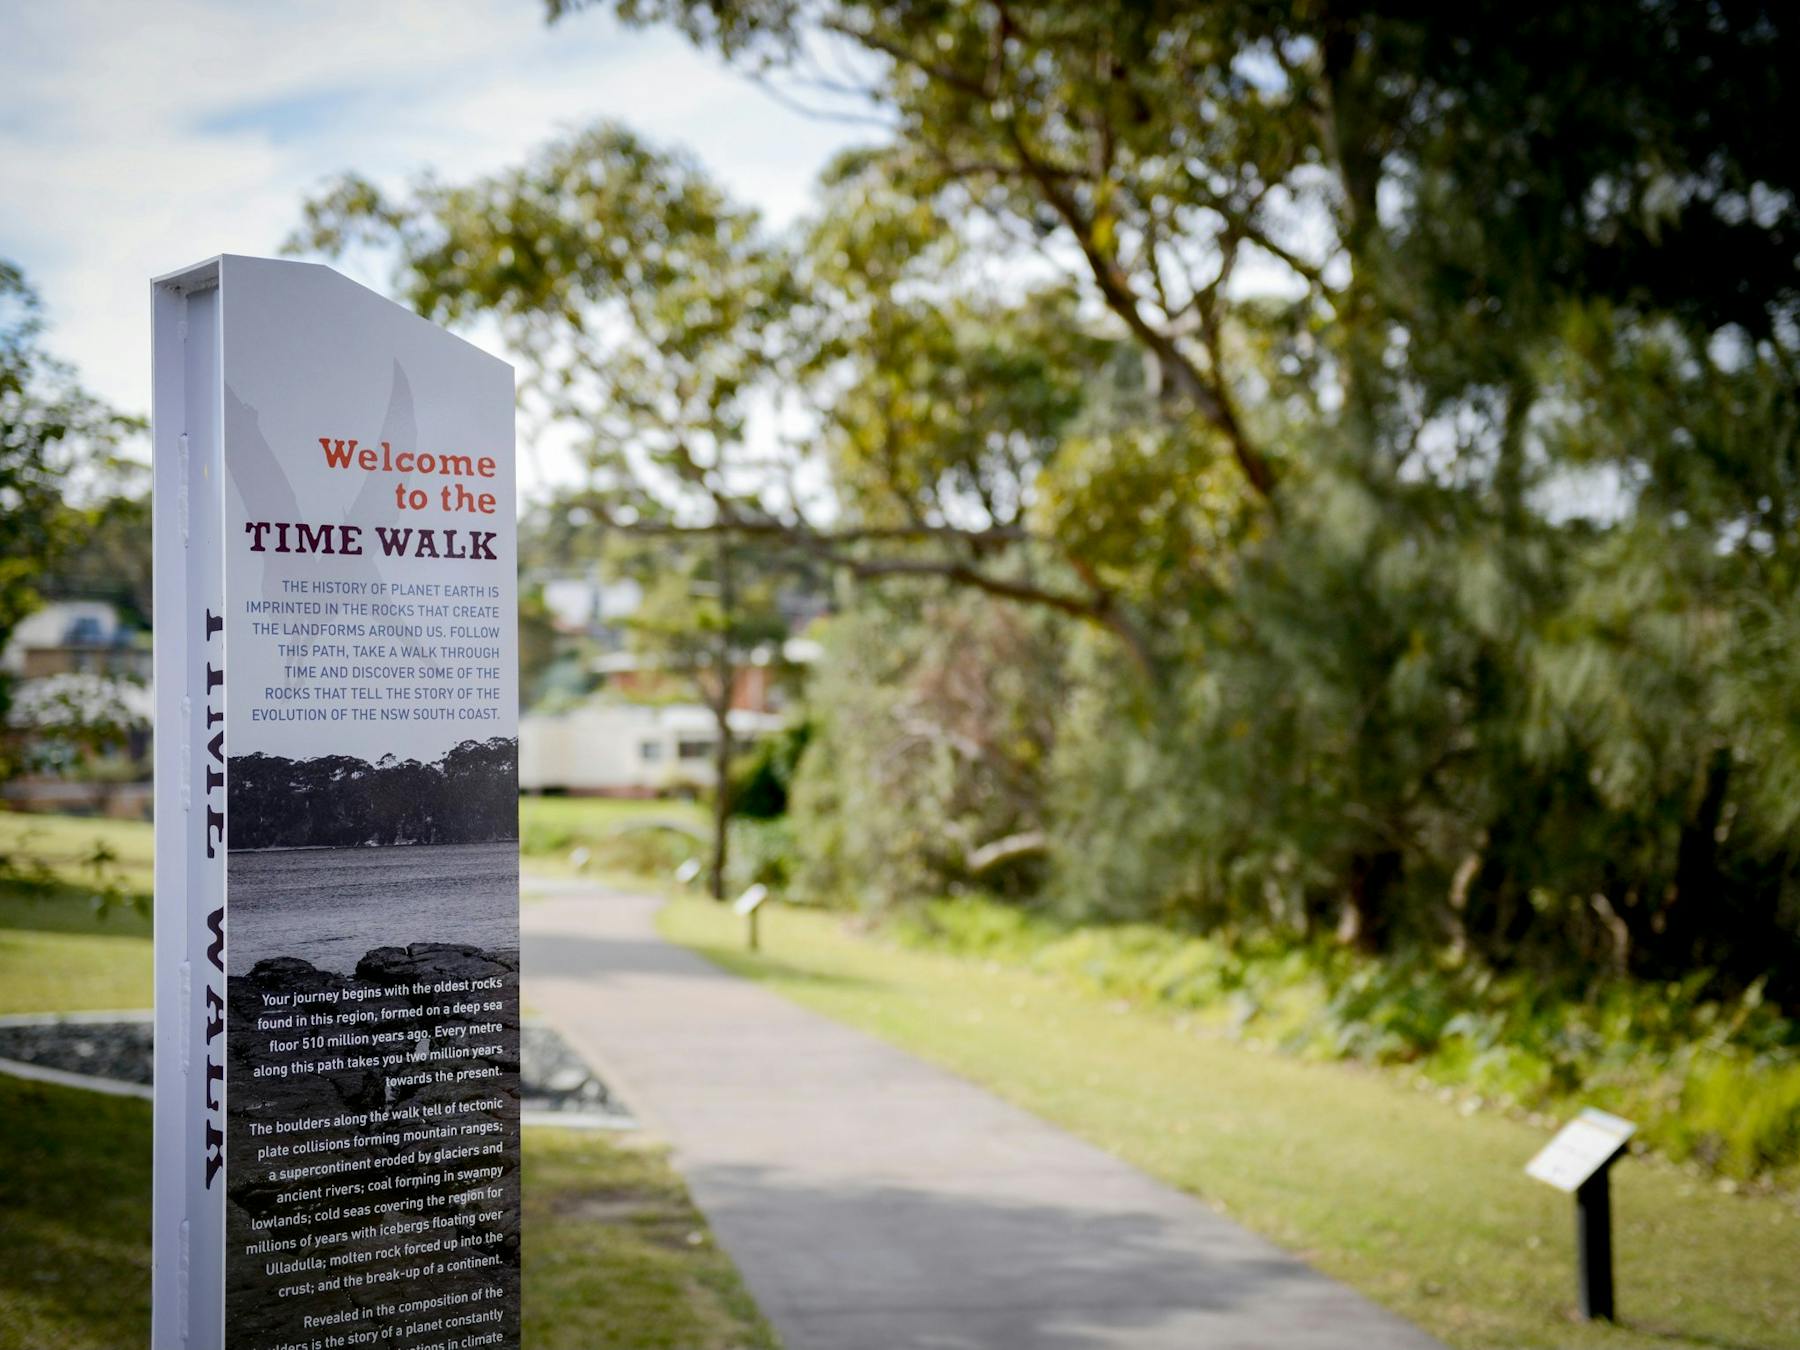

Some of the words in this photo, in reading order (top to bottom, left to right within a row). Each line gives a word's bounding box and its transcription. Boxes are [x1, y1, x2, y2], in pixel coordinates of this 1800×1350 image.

[319, 438, 496, 478] Welcome
[395, 483, 428, 511] to
[440, 484, 497, 514] the
[245, 522, 362, 554] TIME
[375, 527, 497, 560] WALK
[281, 580, 308, 592] THE
[312, 580, 367, 594] HISTORY
[370, 582, 386, 594] OF
[391, 584, 440, 596] PLANET
[444, 585, 484, 596] EARTH
[488, 586, 498, 597] IS
[246, 601, 320, 614] IMPRINTED
[325, 602, 338, 614] IN
[342, 602, 367, 615] THE
[372, 603, 414, 616] ROCKS
[418, 605, 448, 616] THAT
[453, 606, 498, 617] CREATE
[252, 622, 279, 634] THE
[283, 623, 365, 636] LANDFORMS
[368, 625, 422, 636] AROUND
[426, 626, 445, 637] US.
[450, 626, 499, 638] FOLLOW
[278, 644, 308, 656] THIS
[312, 644, 348, 658] PATH,
[352, 645, 385, 657] TAKE
[388, 646, 397, 657] A
[400, 646, 437, 657] WALK
[440, 646, 499, 658] THROUGH
[284, 665, 316, 678] TIME
[320, 666, 348, 678] AND
[352, 666, 414, 678] DISCOVER
[418, 666, 453, 678] SOME
[457, 667, 472, 678] OF
[476, 667, 499, 678] THE
[265, 687, 310, 699] ROCKS
[314, 687, 347, 699] THAT
[350, 687, 382, 699] TELL
[386, 687, 410, 699] THE
[414, 687, 454, 699] STORY
[457, 688, 472, 698] OF
[476, 687, 499, 698] THE
[252, 708, 326, 720] EVOLUTION
[330, 708, 347, 720] OF
[351, 708, 376, 720] THE
[380, 708, 410, 720] NSW
[413, 708, 454, 719] SOUTH
[458, 708, 500, 720] COAST.
[262, 993, 290, 1005] Your
[293, 991, 339, 1006] journey
[342, 986, 381, 1001] begins
[384, 984, 409, 996] with
[412, 982, 431, 994] the
[434, 979, 469, 992] oldest
[470, 978, 502, 992] rocks
[257, 1015, 292, 1029] found
[296, 1014, 307, 1026] in
[310, 1012, 333, 1025] this
[336, 1009, 378, 1025] region,
[380, 1005, 422, 1019] formed
[426, 1006, 440, 1015] on
[442, 1005, 450, 1014] a
[452, 1001, 480, 1014] deep
[482, 1000, 503, 1010] sea
[269, 1039, 299, 1051] floor
[302, 1036, 324, 1049] 510
[327, 1032, 368, 1046] million
[371, 1031, 404, 1045] years
[406, 1029, 431, 1043] ago.
[434, 1025, 466, 1038] Every
[469, 1022, 502, 1034] metre
[253, 1064, 287, 1077] along
[291, 1060, 314, 1073] this
[317, 1057, 344, 1073] path
[347, 1055, 379, 1067] takes
[382, 1054, 402, 1067] you
[406, 1052, 427, 1062] two
[430, 1047, 469, 1060] million
[471, 1044, 503, 1058] years
[386, 1075, 432, 1088] towards
[435, 1070, 453, 1081] the
[456, 1067, 502, 1082] present.
[249, 1123, 272, 1135] The
[276, 1117, 330, 1132] boulders
[333, 1114, 367, 1126] along
[369, 1110, 388, 1122] the
[391, 1106, 419, 1119] walk
[422, 1104, 442, 1116] tell
[444, 1101, 456, 1114] of
[458, 1097, 503, 1112] tectonic
[258, 1145, 289, 1161] plate
[292, 1138, 350, 1154] collisions
[353, 1132, 400, 1146] forming
[403, 1124, 457, 1141] mountain
[460, 1122, 502, 1136] ranges;
[268, 1171, 276, 1180] a
[279, 1158, 370, 1180] supercontinent
[374, 1151, 414, 1167] eroded
[418, 1150, 431, 1164] by
[434, 1145, 480, 1163] glaciers
[482, 1141, 502, 1154] and
[276, 1186, 322, 1203] ancient
[325, 1184, 364, 1196] rivers;
[367, 1177, 392, 1191] coal
[394, 1172, 440, 1188] forming
[444, 1170, 454, 1181] in
[457, 1166, 504, 1181] swampy
[251, 1212, 311, 1230] lowlands;
[314, 1207, 340, 1221] cold
[343, 1205, 370, 1217] seas
[374, 1197, 423, 1213] covering
[426, 1194, 445, 1206] the
[448, 1187, 484, 1205] region
[486, 1186, 504, 1198] for
[246, 1239, 296, 1254] millions
[299, 1234, 311, 1246] of
[314, 1232, 348, 1248] years
[350, 1225, 376, 1239] with
[380, 1220, 429, 1236] icebergs
[432, 1213, 475, 1228] floating
[478, 1210, 503, 1221] over
[266, 1257, 326, 1275] Ulladulla;
[330, 1251, 372, 1265] molten
[375, 1245, 401, 1259] rock
[404, 1238, 440, 1255] forced
[443, 1239, 458, 1251] up
[460, 1234, 482, 1247] into
[485, 1231, 503, 1243] the
[278, 1282, 314, 1297] crust;
[318, 1276, 340, 1291] and
[343, 1274, 362, 1287] the
[366, 1267, 420, 1283] break-up
[422, 1262, 434, 1275] of
[436, 1264, 444, 1273] a
[446, 1253, 502, 1271] continent.
[304, 1308, 358, 1328] Revealed
[362, 1306, 372, 1318] in
[376, 1304, 395, 1316] the
[398, 1292, 468, 1312] composition
[471, 1288, 482, 1300] of
[485, 1286, 503, 1298] the
[311, 1338, 321, 1350] is
[325, 1335, 344, 1348] the
[347, 1331, 378, 1344] story
[379, 1325, 392, 1338] of
[395, 1327, 402, 1336] a
[406, 1318, 442, 1337] planet
[445, 1308, 504, 1328] constantly
[447, 1338, 458, 1350] in
[461, 1331, 503, 1348] climate
